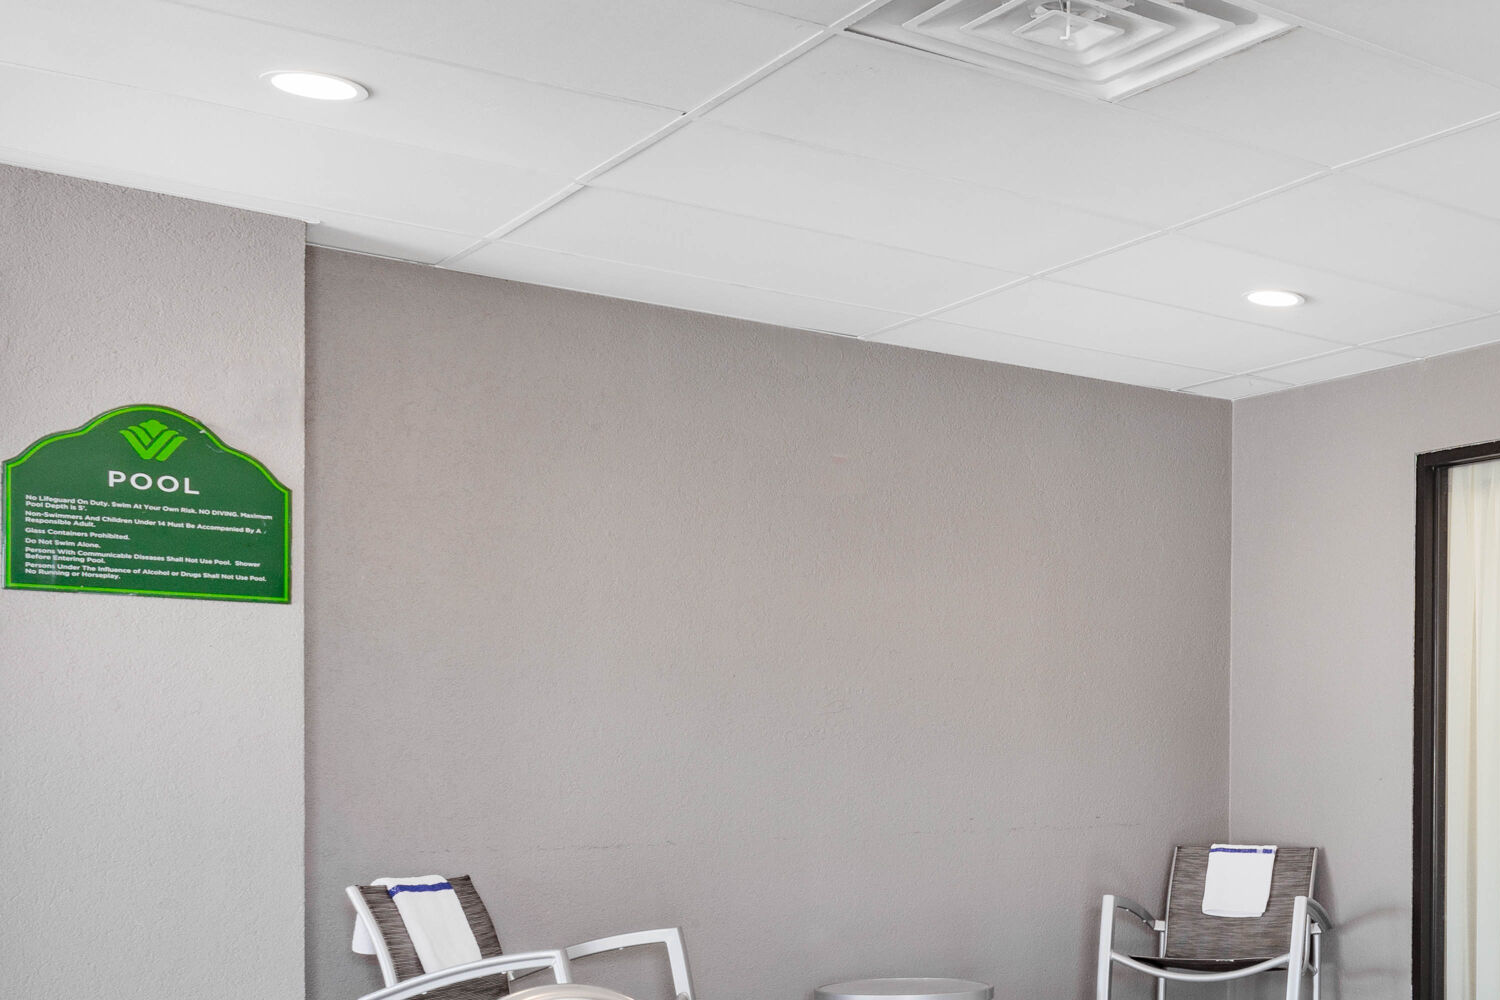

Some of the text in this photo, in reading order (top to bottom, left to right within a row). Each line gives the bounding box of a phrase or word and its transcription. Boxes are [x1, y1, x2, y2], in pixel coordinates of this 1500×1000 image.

[108, 470, 200, 495] POOL
[39, 496, 75, 504] Lifeguard
[45, 502, 68, 510] Depth
[25, 517, 72, 525] Responsible
[25, 510, 83, 520] Non-Swimmers
[102, 516, 132, 524] Children
[197, 524, 244, 533] Accompanied
[48, 529, 88, 537] Containers
[90, 532, 130, 540] Prohibited.
[77, 550, 132, 559] Communicable
[52, 555, 85, 563] Entering
[98, 566, 131, 574] Influence
[82, 572, 120, 580] Horseplay.
